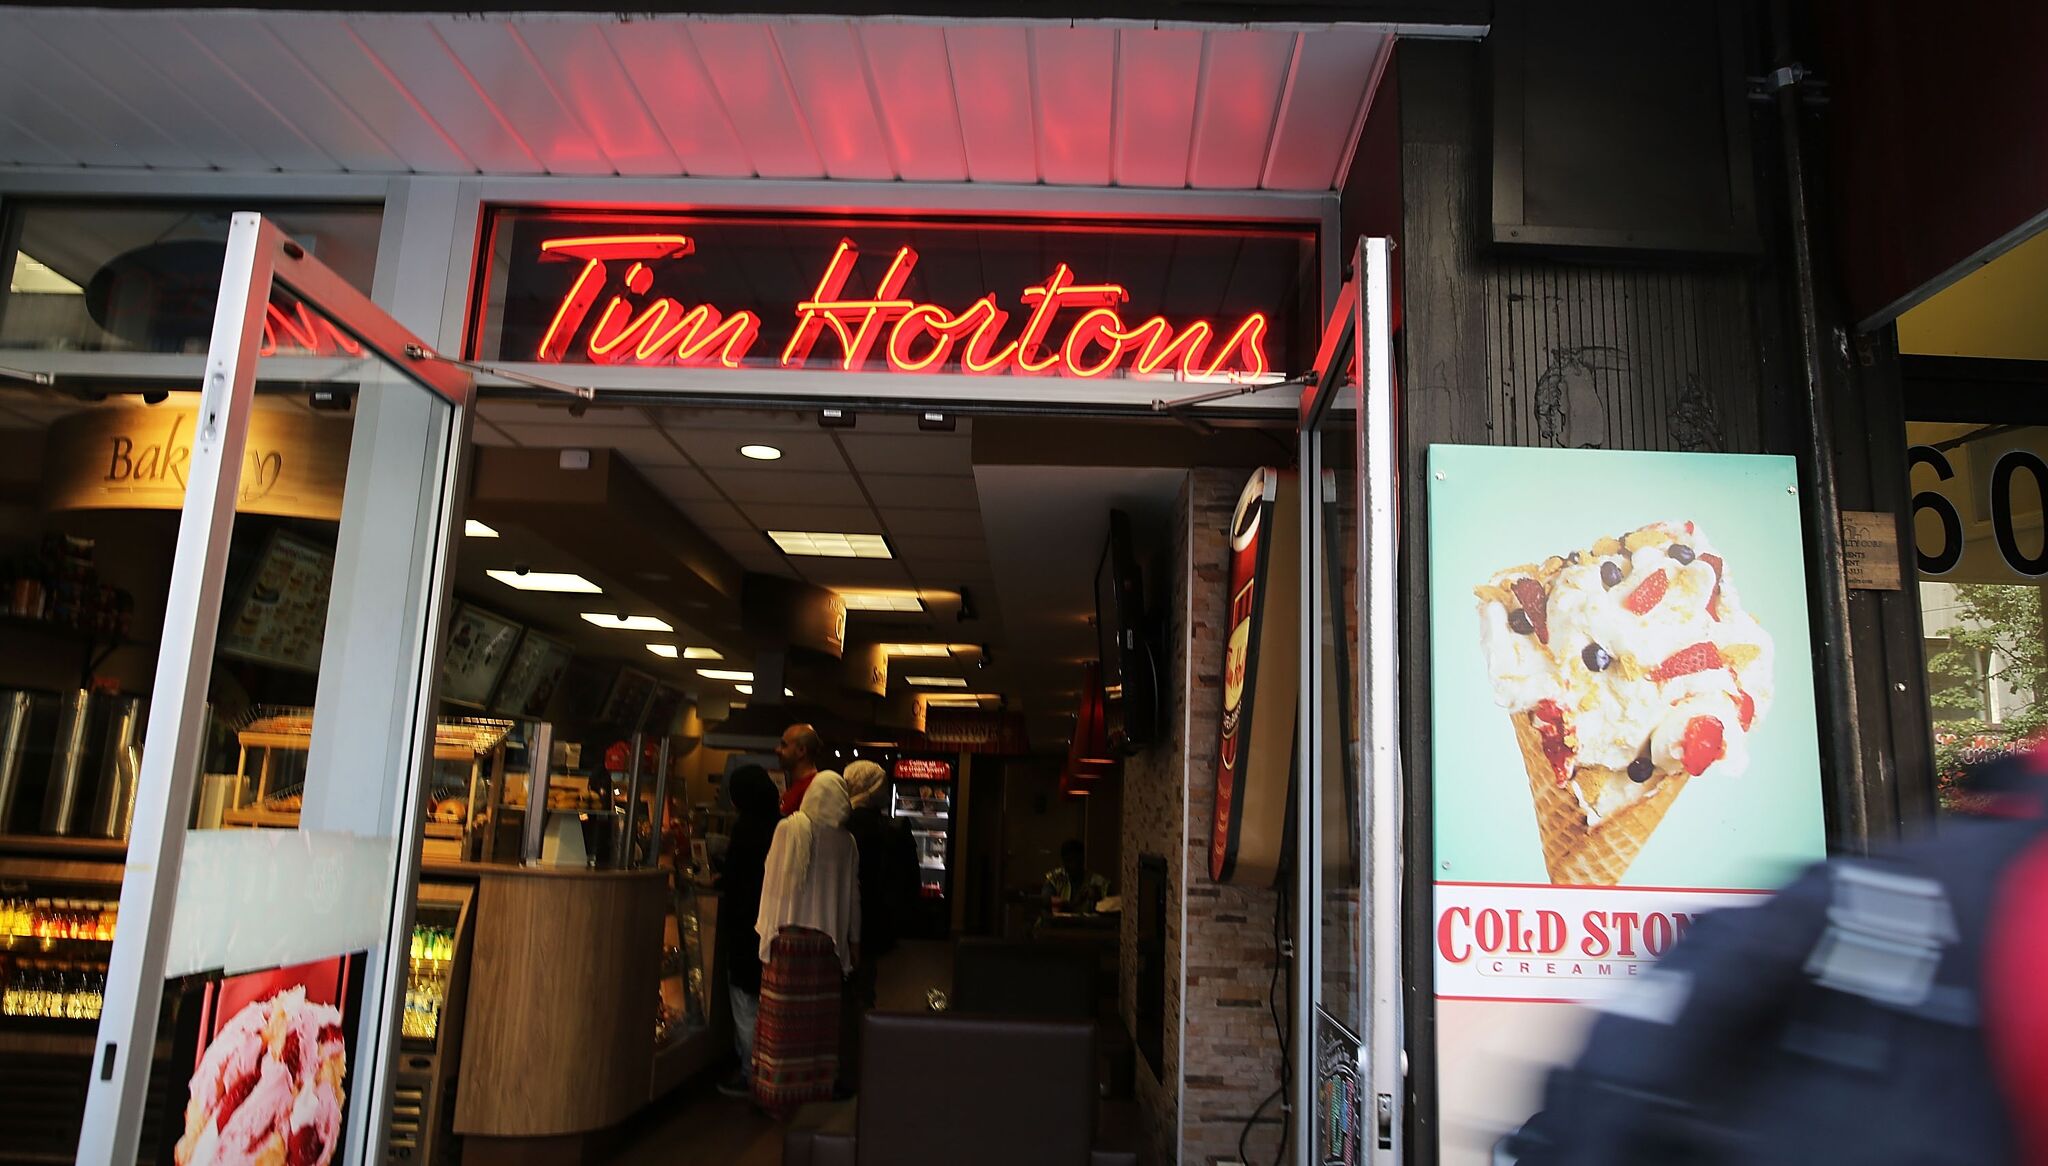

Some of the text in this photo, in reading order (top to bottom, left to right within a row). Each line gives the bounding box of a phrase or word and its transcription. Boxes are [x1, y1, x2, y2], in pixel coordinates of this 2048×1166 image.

[538, 234, 1269, 384] Tim Hortons
[103, 413, 283, 501] Baky
[1437, 906, 1705, 963] COLD STON
[1492, 961, 1637, 976] CREAME
